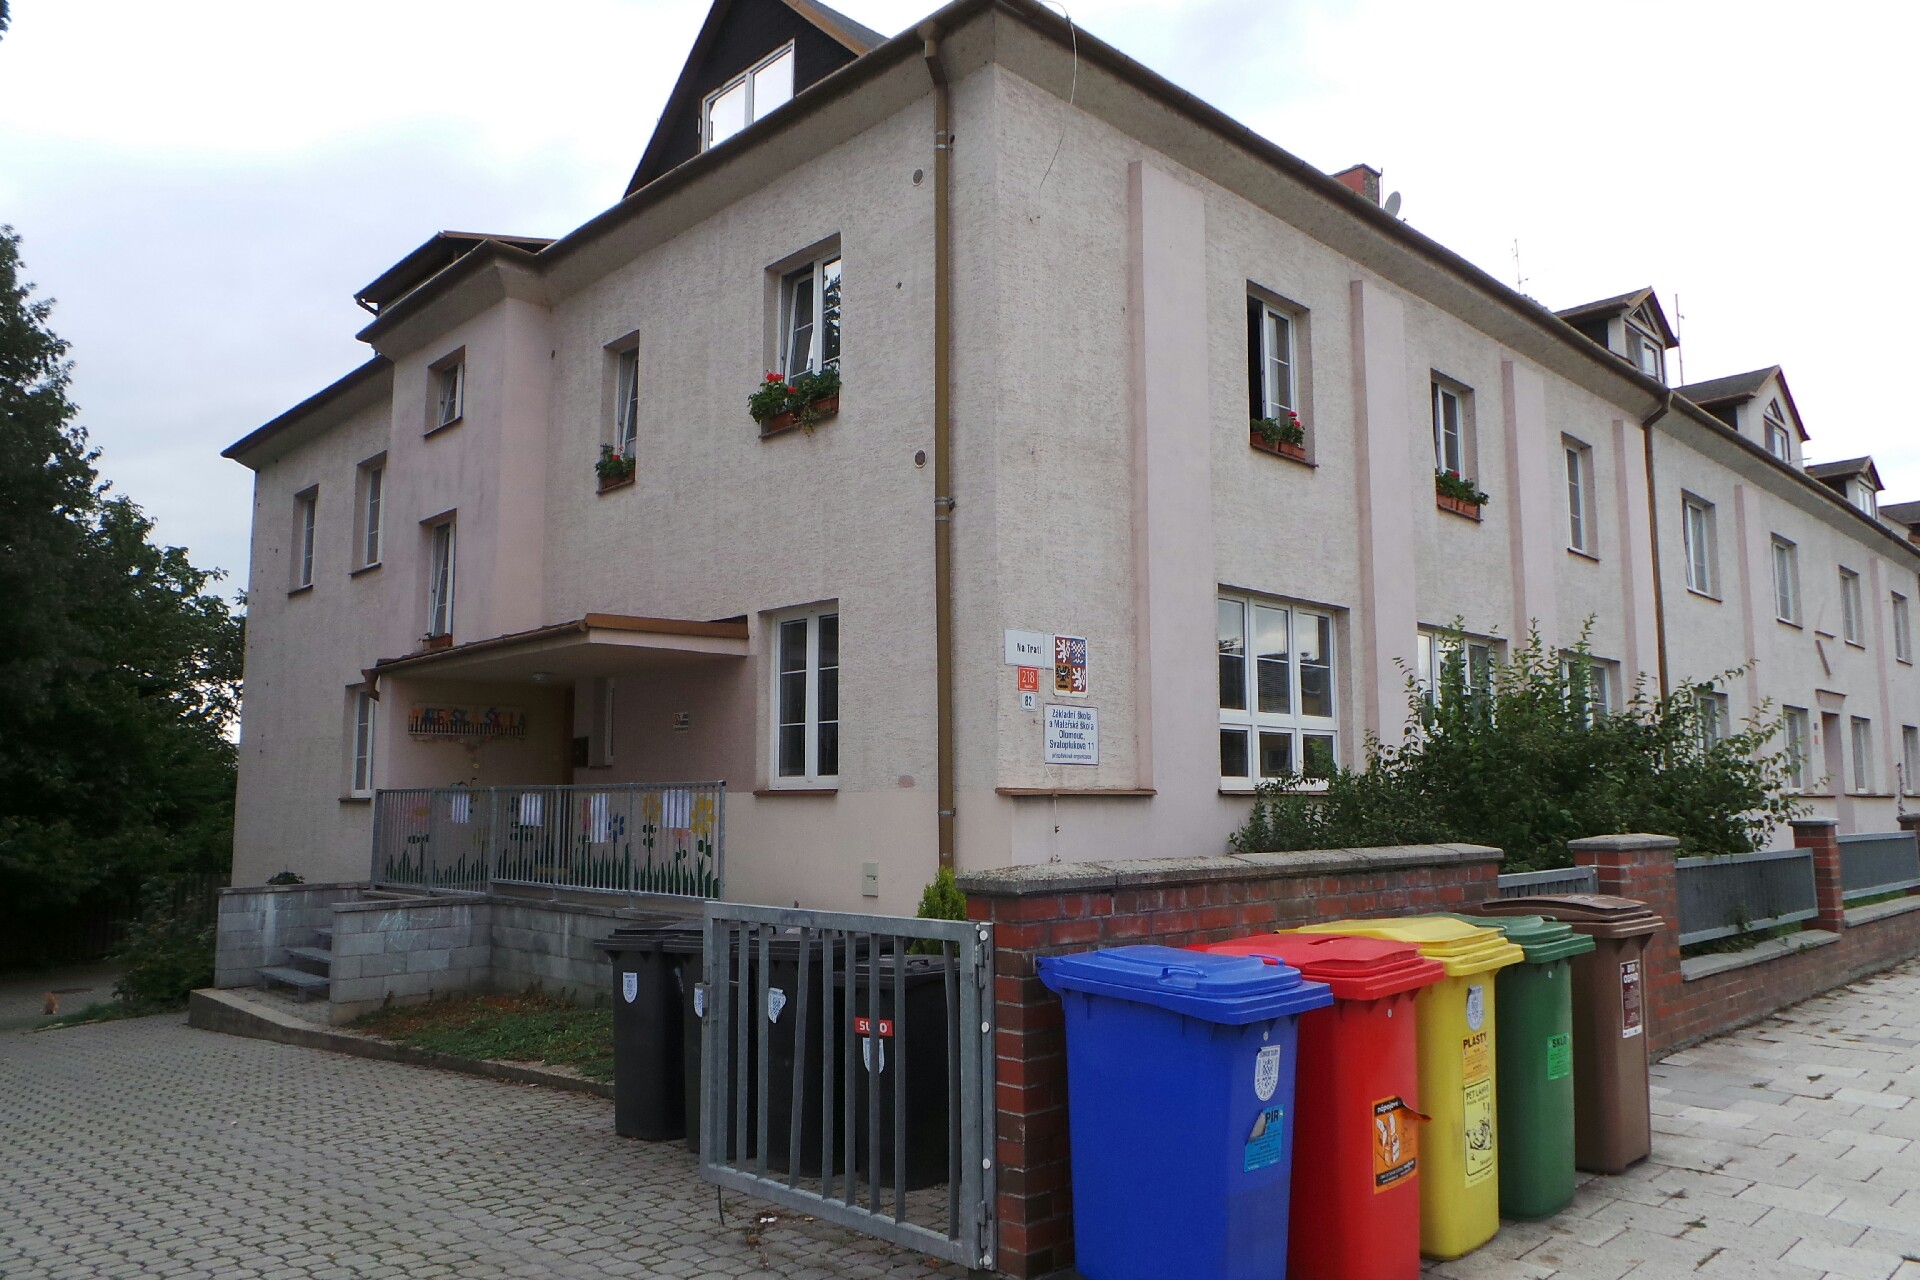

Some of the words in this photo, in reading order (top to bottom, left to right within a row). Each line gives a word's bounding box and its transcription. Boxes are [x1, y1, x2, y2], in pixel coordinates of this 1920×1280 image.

[1016, 643, 1025, 653] Na
[1021, 671, 1035, 684] 218
[1024, 695, 1032, 707] 82
[1052, 709, 1076, 719] Základní
[1077, 710, 1091, 720] škola
[1087, 742, 1095, 751] 11
[859, 1020, 888, 1034] SUO
[1463, 1032, 1487, 1049] PLASTY
